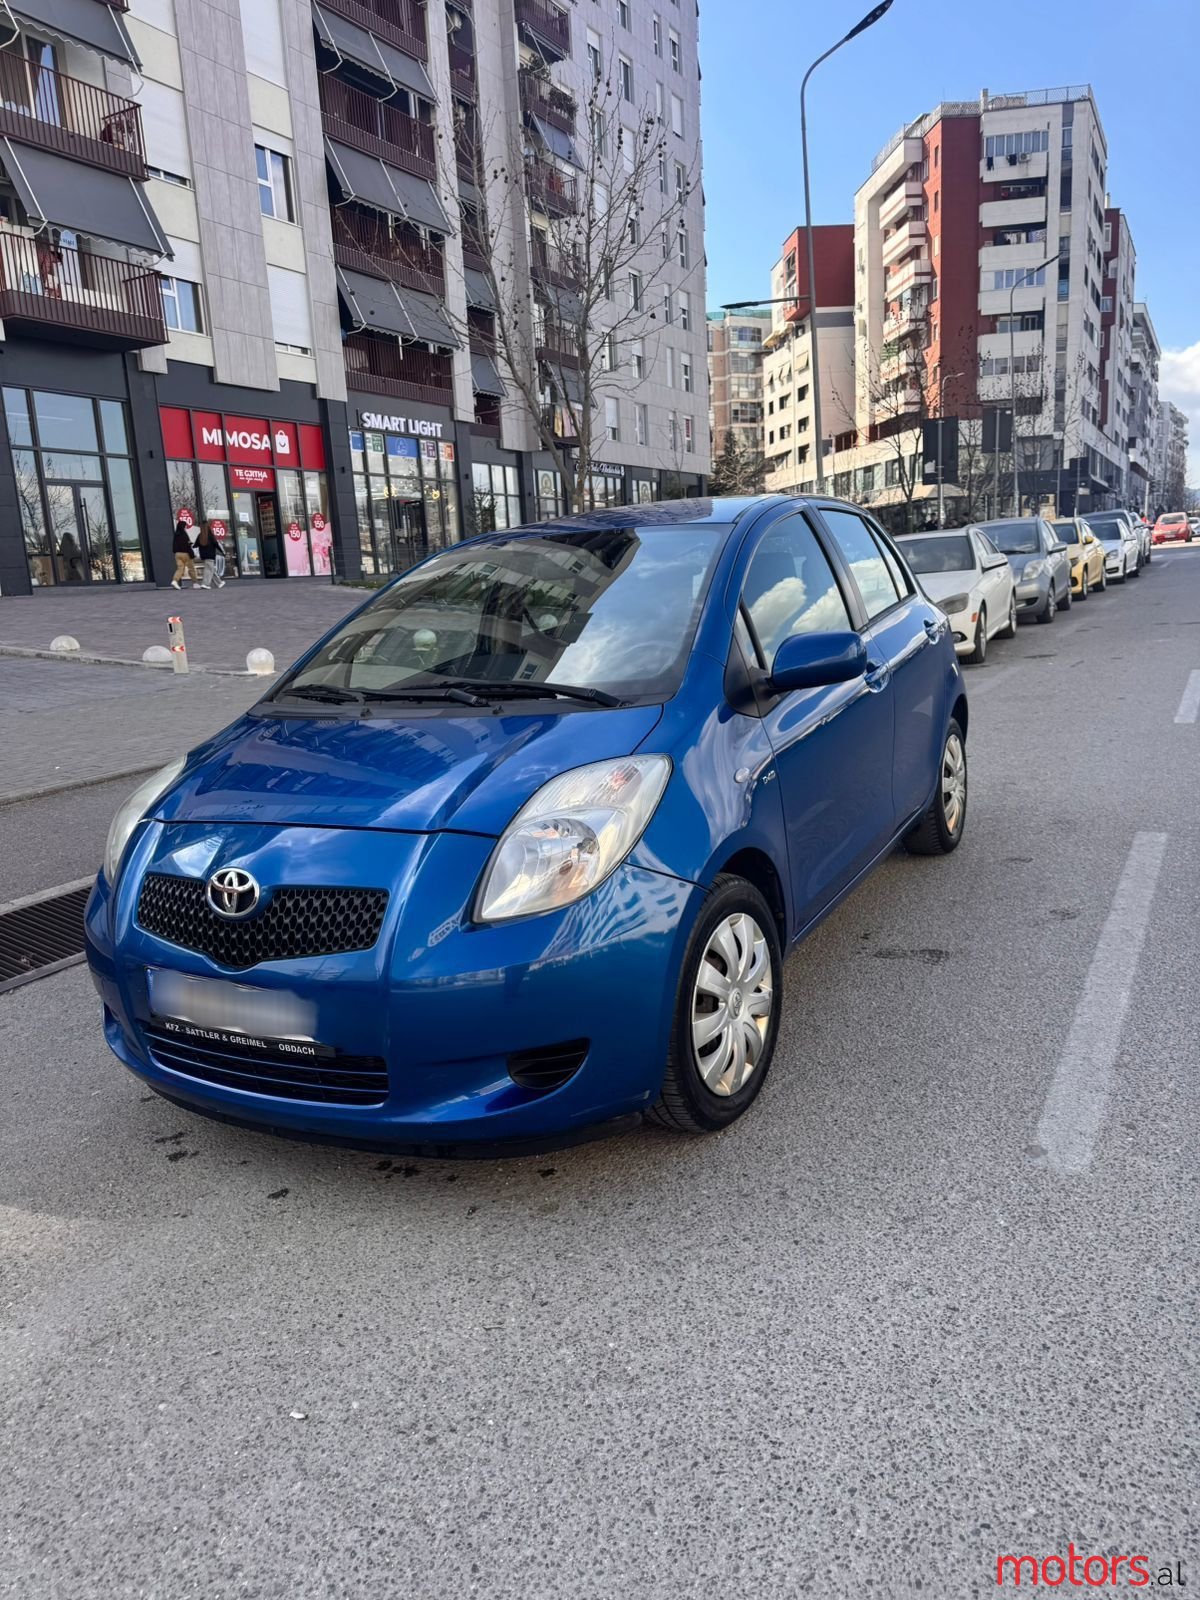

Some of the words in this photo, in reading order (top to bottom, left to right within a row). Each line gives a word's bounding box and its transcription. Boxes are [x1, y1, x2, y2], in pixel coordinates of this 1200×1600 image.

[361, 412, 407, 433] SMART
[408, 418, 443, 438] LIGHT
[202, 427, 272, 450] MIMOSA
[213, 527, 225, 537] 150
[313, 519, 325, 529] 150
[290, 530, 301, 539] 150
[165, 1022, 180, 1032] KFZ
[185, 1027, 220, 1040] SATTLER
[222, 1033, 228, 1041] &
[229, 1035, 267, 1048] GREIMEL
[278, 1043, 315, 1055] OBDACH
